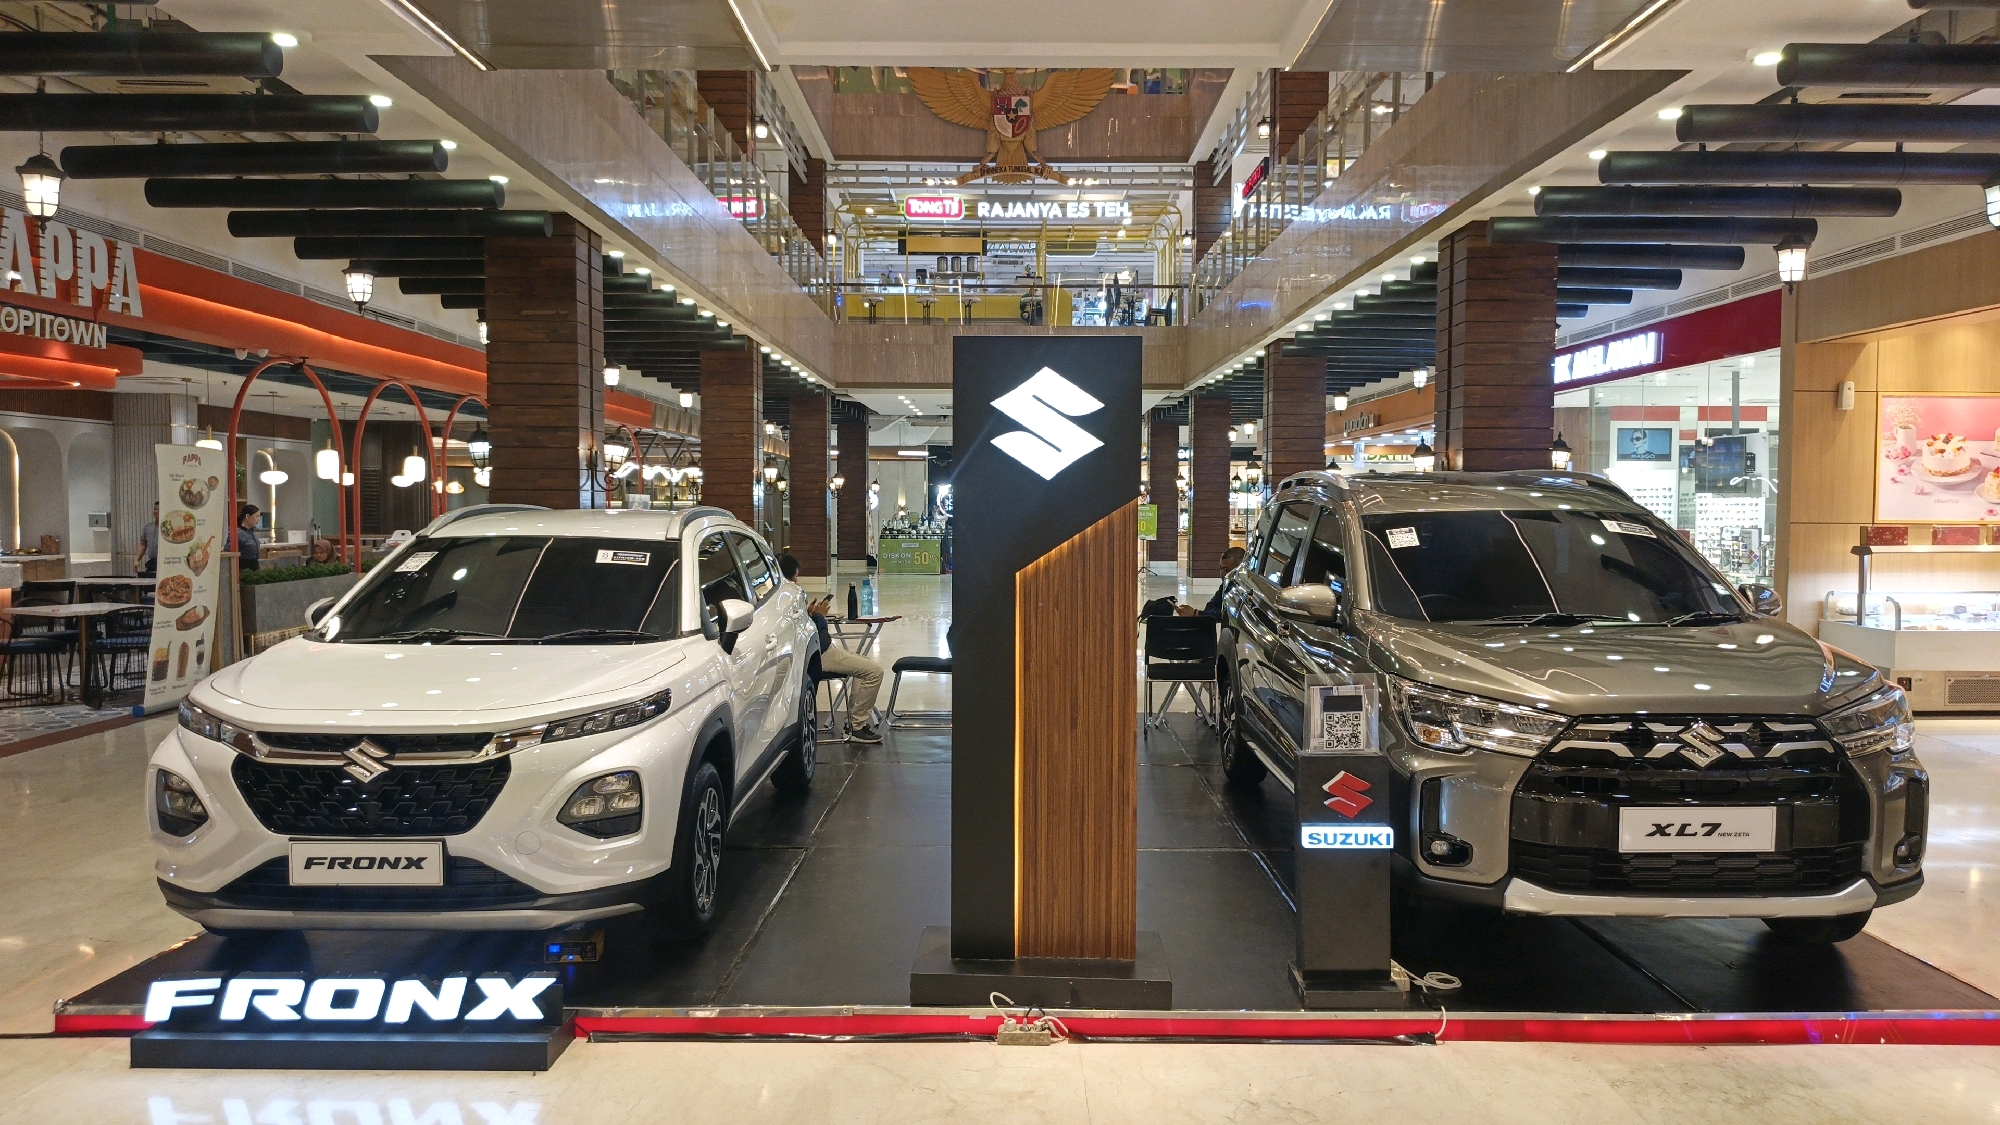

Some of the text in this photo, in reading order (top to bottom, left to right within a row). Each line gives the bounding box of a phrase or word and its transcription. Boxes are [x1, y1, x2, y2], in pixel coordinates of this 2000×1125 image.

[909, 199, 942, 214] TONG
[977, 202, 1062, 218] RAJANYA
[1066, 202, 1090, 217] ES
[1645, 822, 1722, 837] XL7
[1307, 832, 1391, 846] SUZUKI
[303, 856, 428, 870] FRONX
[144, 977, 557, 1023] FRONX
